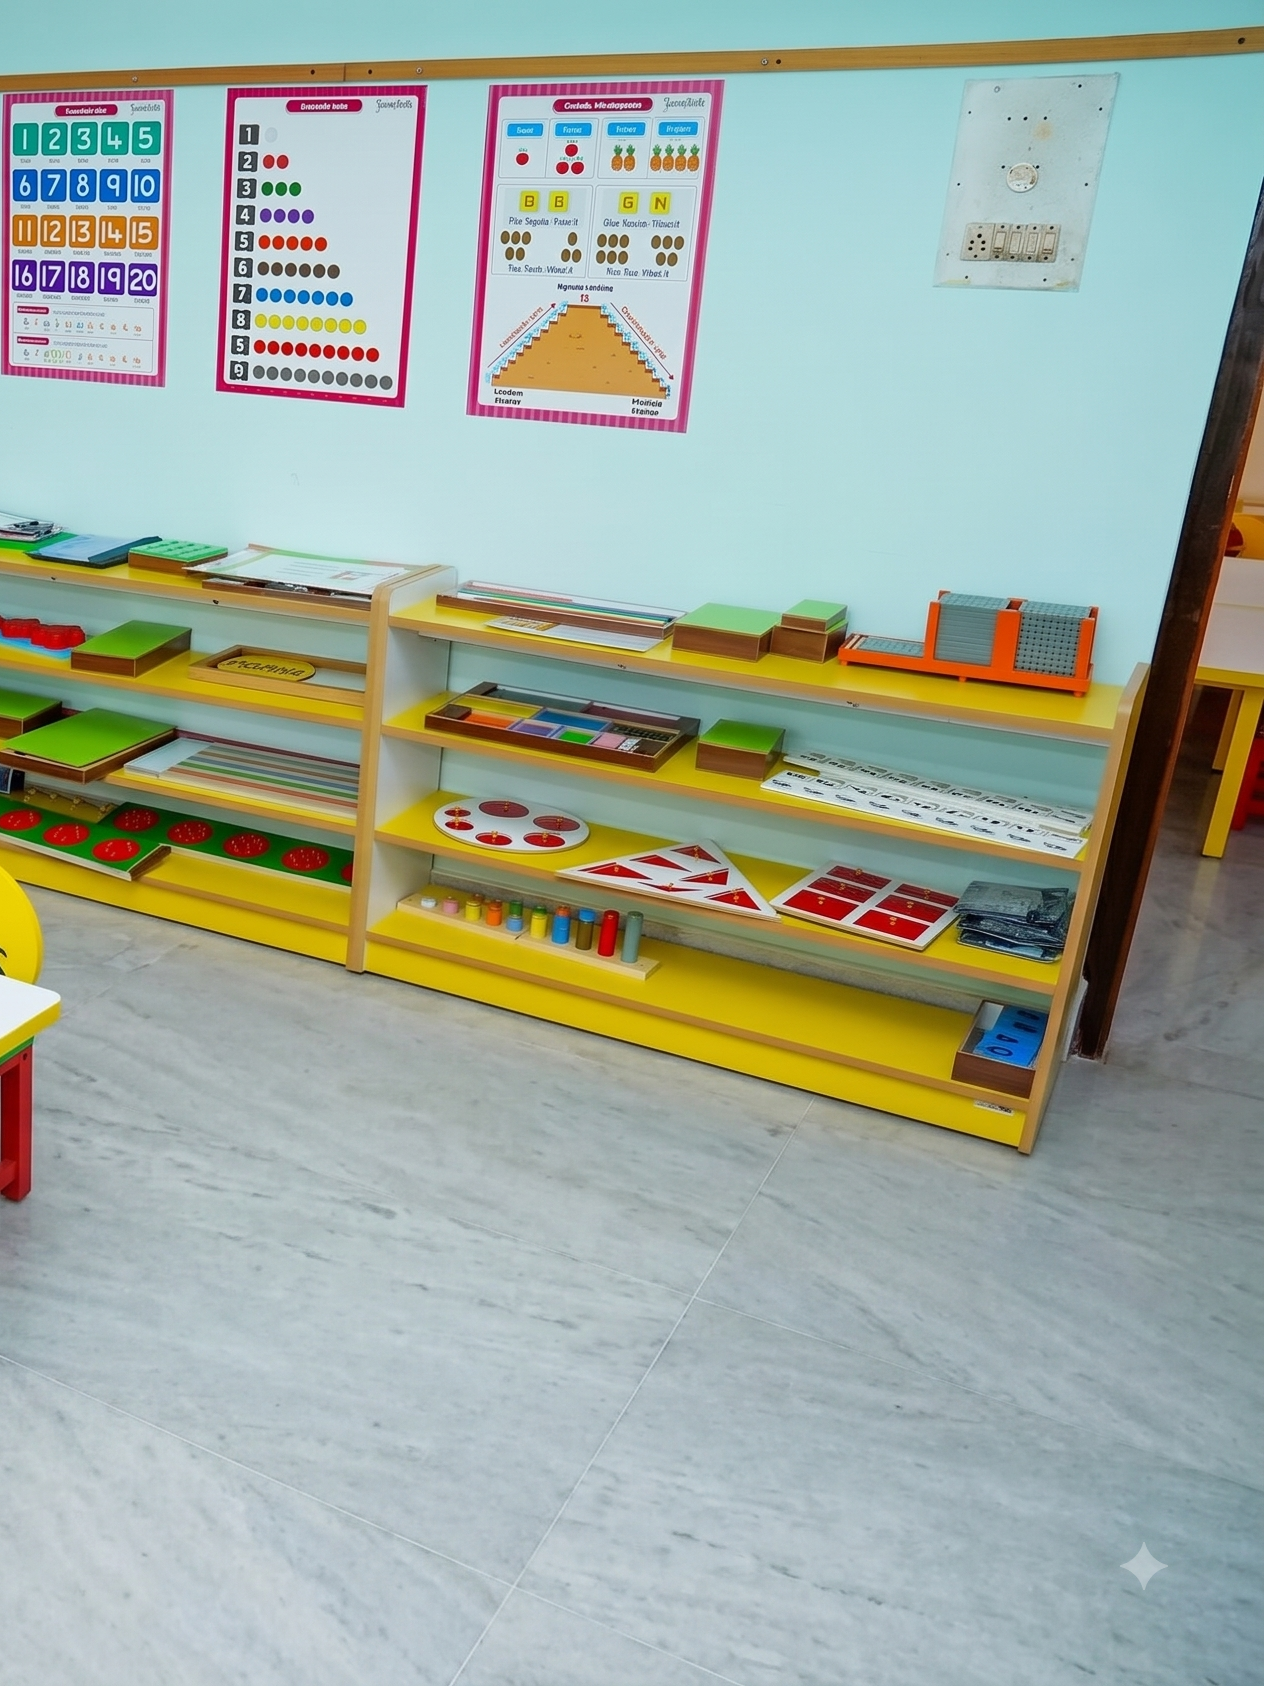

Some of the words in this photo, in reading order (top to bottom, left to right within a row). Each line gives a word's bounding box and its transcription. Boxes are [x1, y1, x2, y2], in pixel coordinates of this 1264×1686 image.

[48, 128, 61, 150] 2
[77, 127, 91, 150] 3
[107, 126, 122, 150] 4
[138, 126, 153, 149] 5
[245, 127, 252, 143] 1
[243, 154, 253, 169] 2
[19, 174, 31, 197] 6
[47, 174, 61, 197] 7
[76, 173, 90, 197] 8
[107, 174, 120, 197] 9
[134, 174, 155, 197] 10
[242, 181, 251, 196] 3
[524, 195, 535, 208] B
[554, 195, 564, 208] B
[623, 196, 633, 209] G
[655, 196, 667, 210] N
[240, 207, 250, 222] 4
[18, 220, 31, 242] 11
[43, 220, 61, 242] 12
[71, 220, 90, 243] 13
[101, 221, 123, 244] 14
[132, 221, 153, 244] 15
[239, 234, 248, 249] 5
[238, 260, 248, 275] 6
[15, 264, 33, 287] 16
[42, 265, 62, 288] 17
[71, 266, 90, 289] 18
[101, 267, 120, 290] 19
[130, 268, 157, 291] 20
[237, 286, 246, 301] 7
[236, 312, 246, 327] 8
[236, 338, 244, 352] 5
